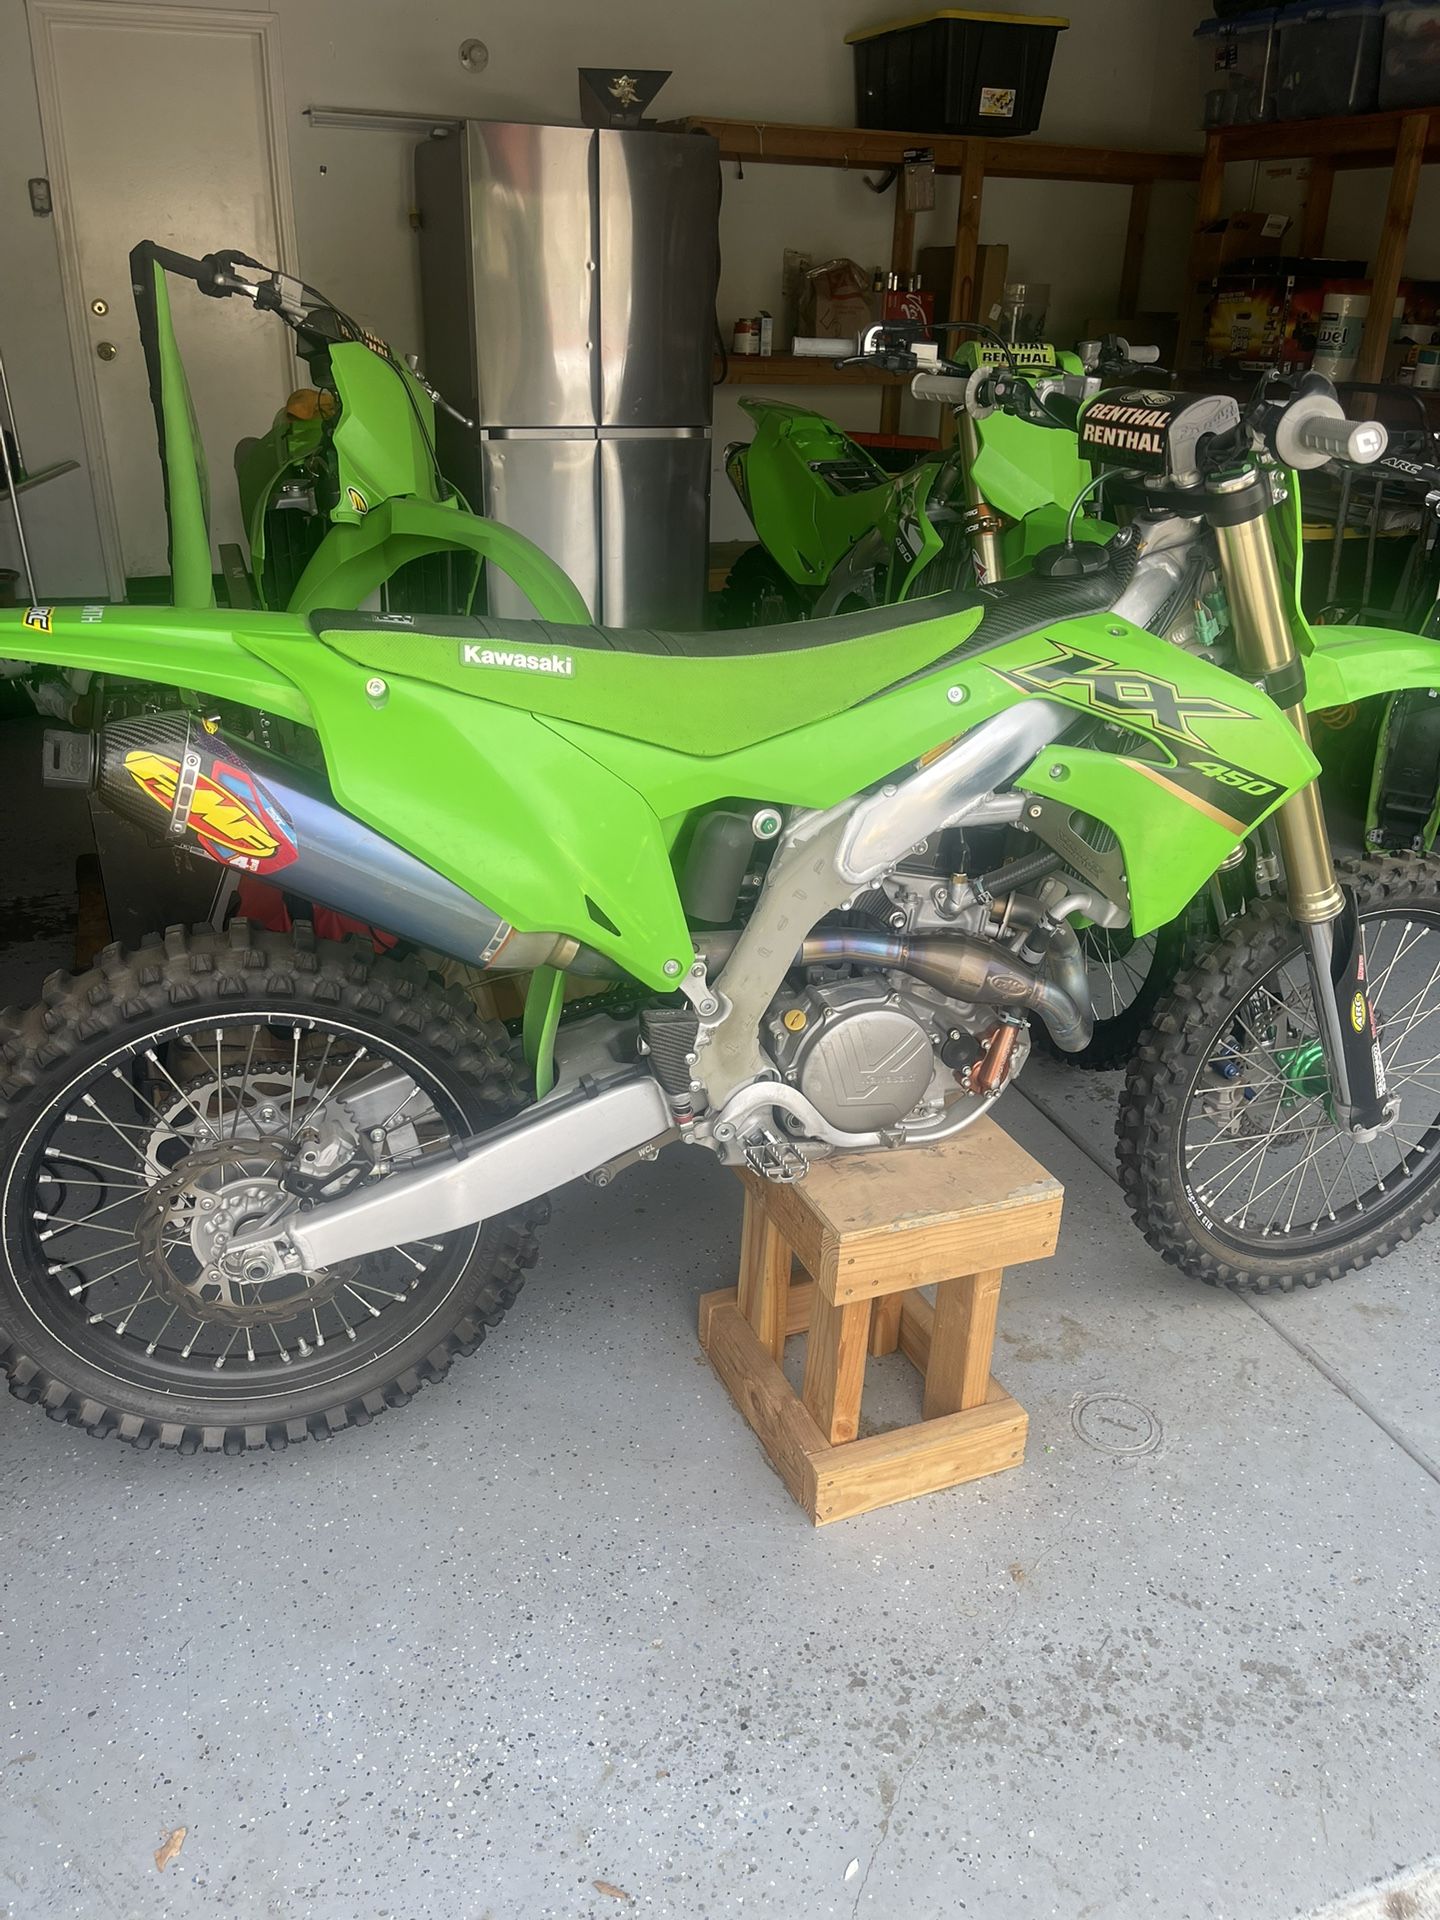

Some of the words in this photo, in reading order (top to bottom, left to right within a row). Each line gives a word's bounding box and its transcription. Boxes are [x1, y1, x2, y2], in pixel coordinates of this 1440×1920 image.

[982, 352, 1051, 364] RENTHAL
[1085, 403, 1172, 428] RENTHAL
[1082, 423, 1163, 453] RENTHAL
[1380, 457, 1422, 475] ARC
[895, 537, 912, 563] 450
[463, 644, 573, 675] Kawasaki
[1006, 637, 1263, 756] KX
[1189, 761, 1277, 796] 450
[123, 754, 281, 852] FMF
[1354, 993, 1363, 1031] ARC
[637, 1143, 656, 1157] WCL
